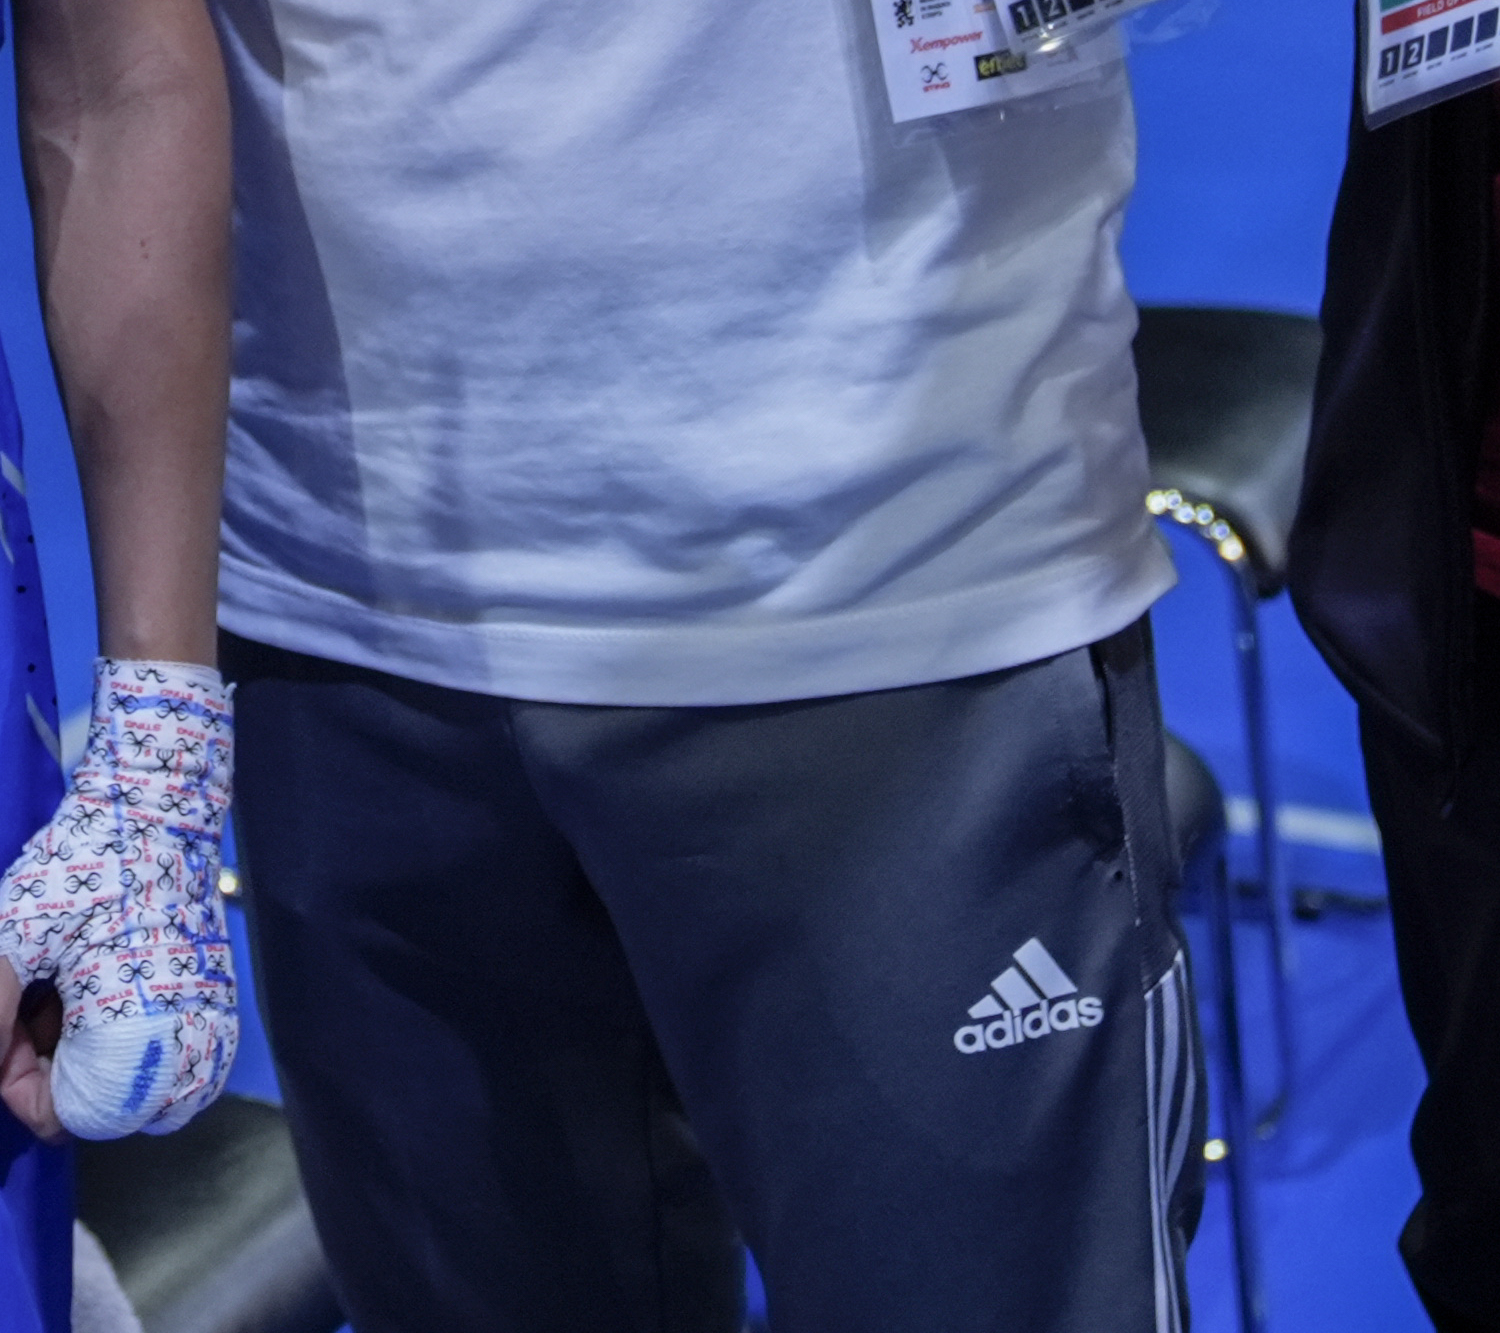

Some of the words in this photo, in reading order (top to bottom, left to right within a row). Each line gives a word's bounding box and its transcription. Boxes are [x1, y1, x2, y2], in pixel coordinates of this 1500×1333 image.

[1417, 0, 1444, 18] FIELD
[1017, 5, 1030, 27] 1
[1386, 51, 1394, 72] 1
[1407, 43, 1419, 65] 2
[110, 682, 143, 693] STING
[161, 689, 193, 701] STING
[125, 720, 161, 731] STING
[177, 727, 205, 740] STING
[114, 774, 150, 785] STING
[127, 809, 164, 824] STING
[66, 862, 104, 872] STING
[12, 870, 48, 883] STING
[37, 900, 74, 910] STING
[117, 950, 153, 962] STING
[149, 983, 183, 991] STING
[96, 990, 133, 1007] STING
[953, 993, 1105, 1054] adidas
